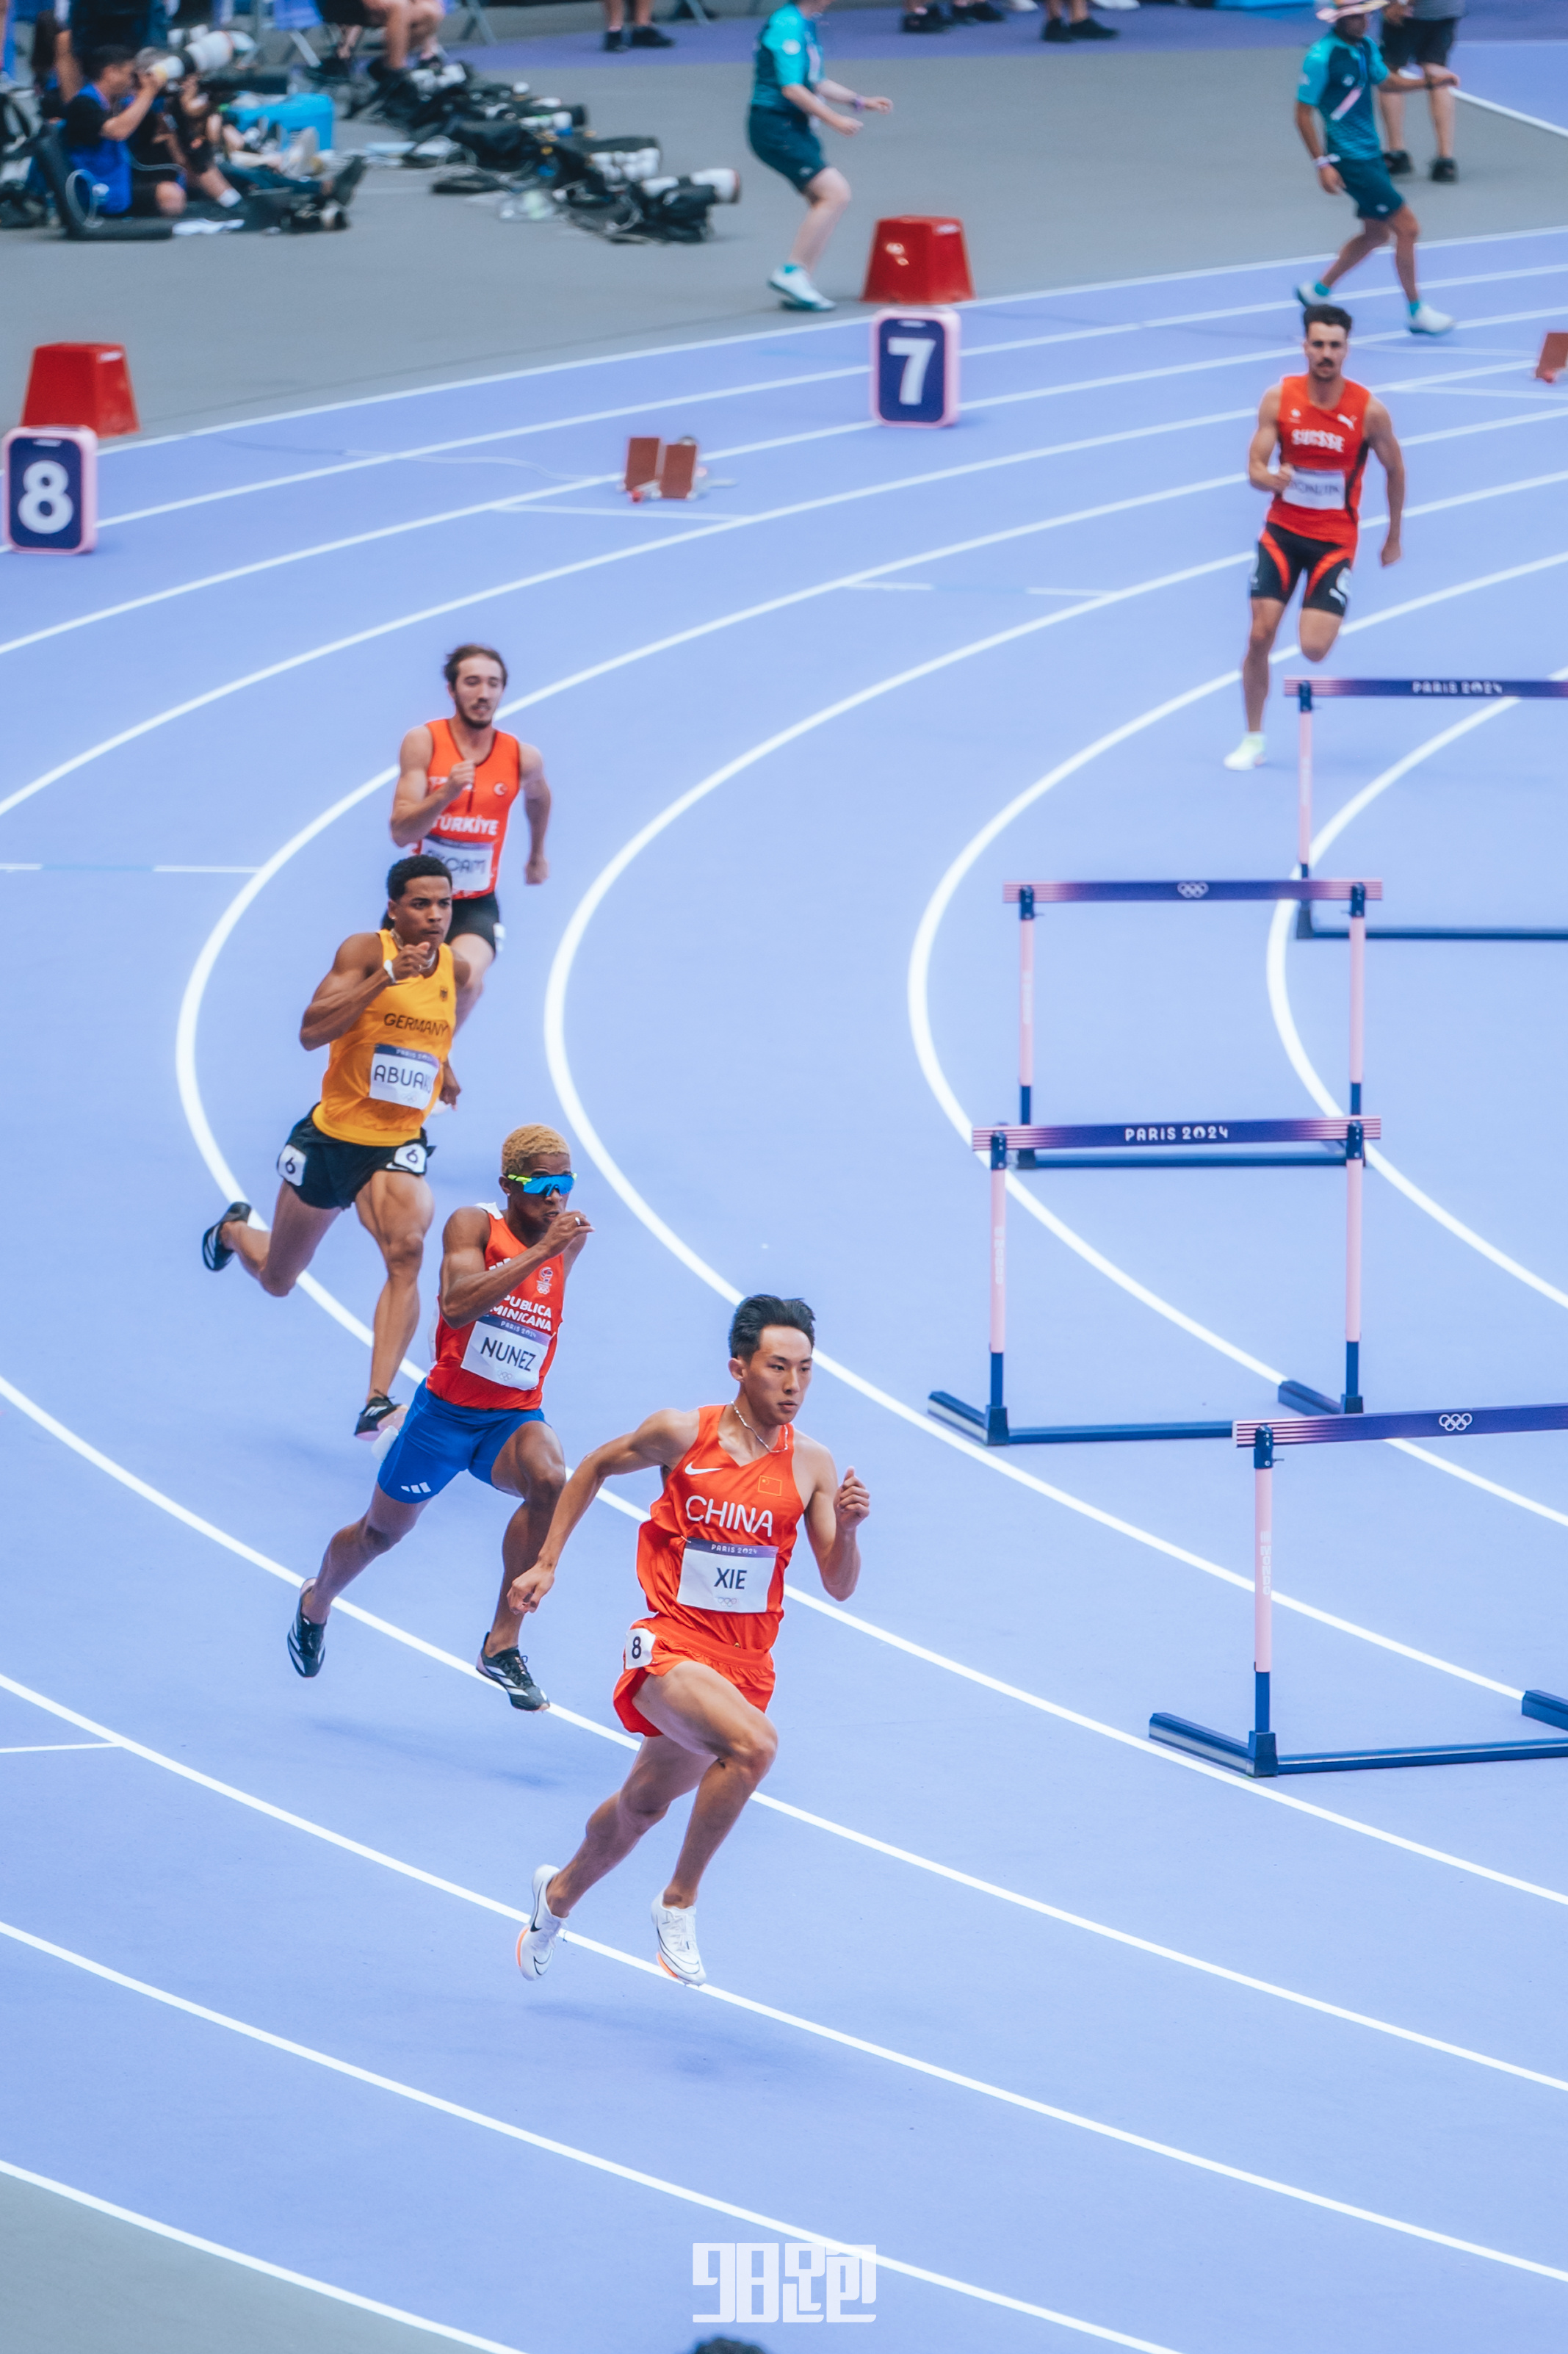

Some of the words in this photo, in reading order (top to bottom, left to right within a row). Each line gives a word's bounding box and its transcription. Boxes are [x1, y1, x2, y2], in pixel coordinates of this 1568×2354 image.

[887, 336, 936, 405] 7
[18, 459, 73, 535] 8
[1412, 680, 1457, 694] PARIS
[1461, 681, 1503, 695] 2024
[383, 1013, 449, 1036] GERMANY
[1124, 1127, 1176, 1141] PARIS
[1182, 1125, 1229, 1140] 2024
[285, 1157, 296, 1174] 6
[406, 1149, 418, 1164] 6
[501, 1321, 520, 1332] PARIS
[521, 1327, 536, 1338] 2024
[480, 1337, 536, 1371] NUNEZ
[685, 1495, 773, 1537] CHINA
[711, 1544, 734, 1553] PARIS
[737, 1547, 757, 1555] 2024
[714, 1567, 747, 1589] XIE
[1260, 1545, 1271, 1595] MONDO
[632, 1636, 642, 1660] 8
